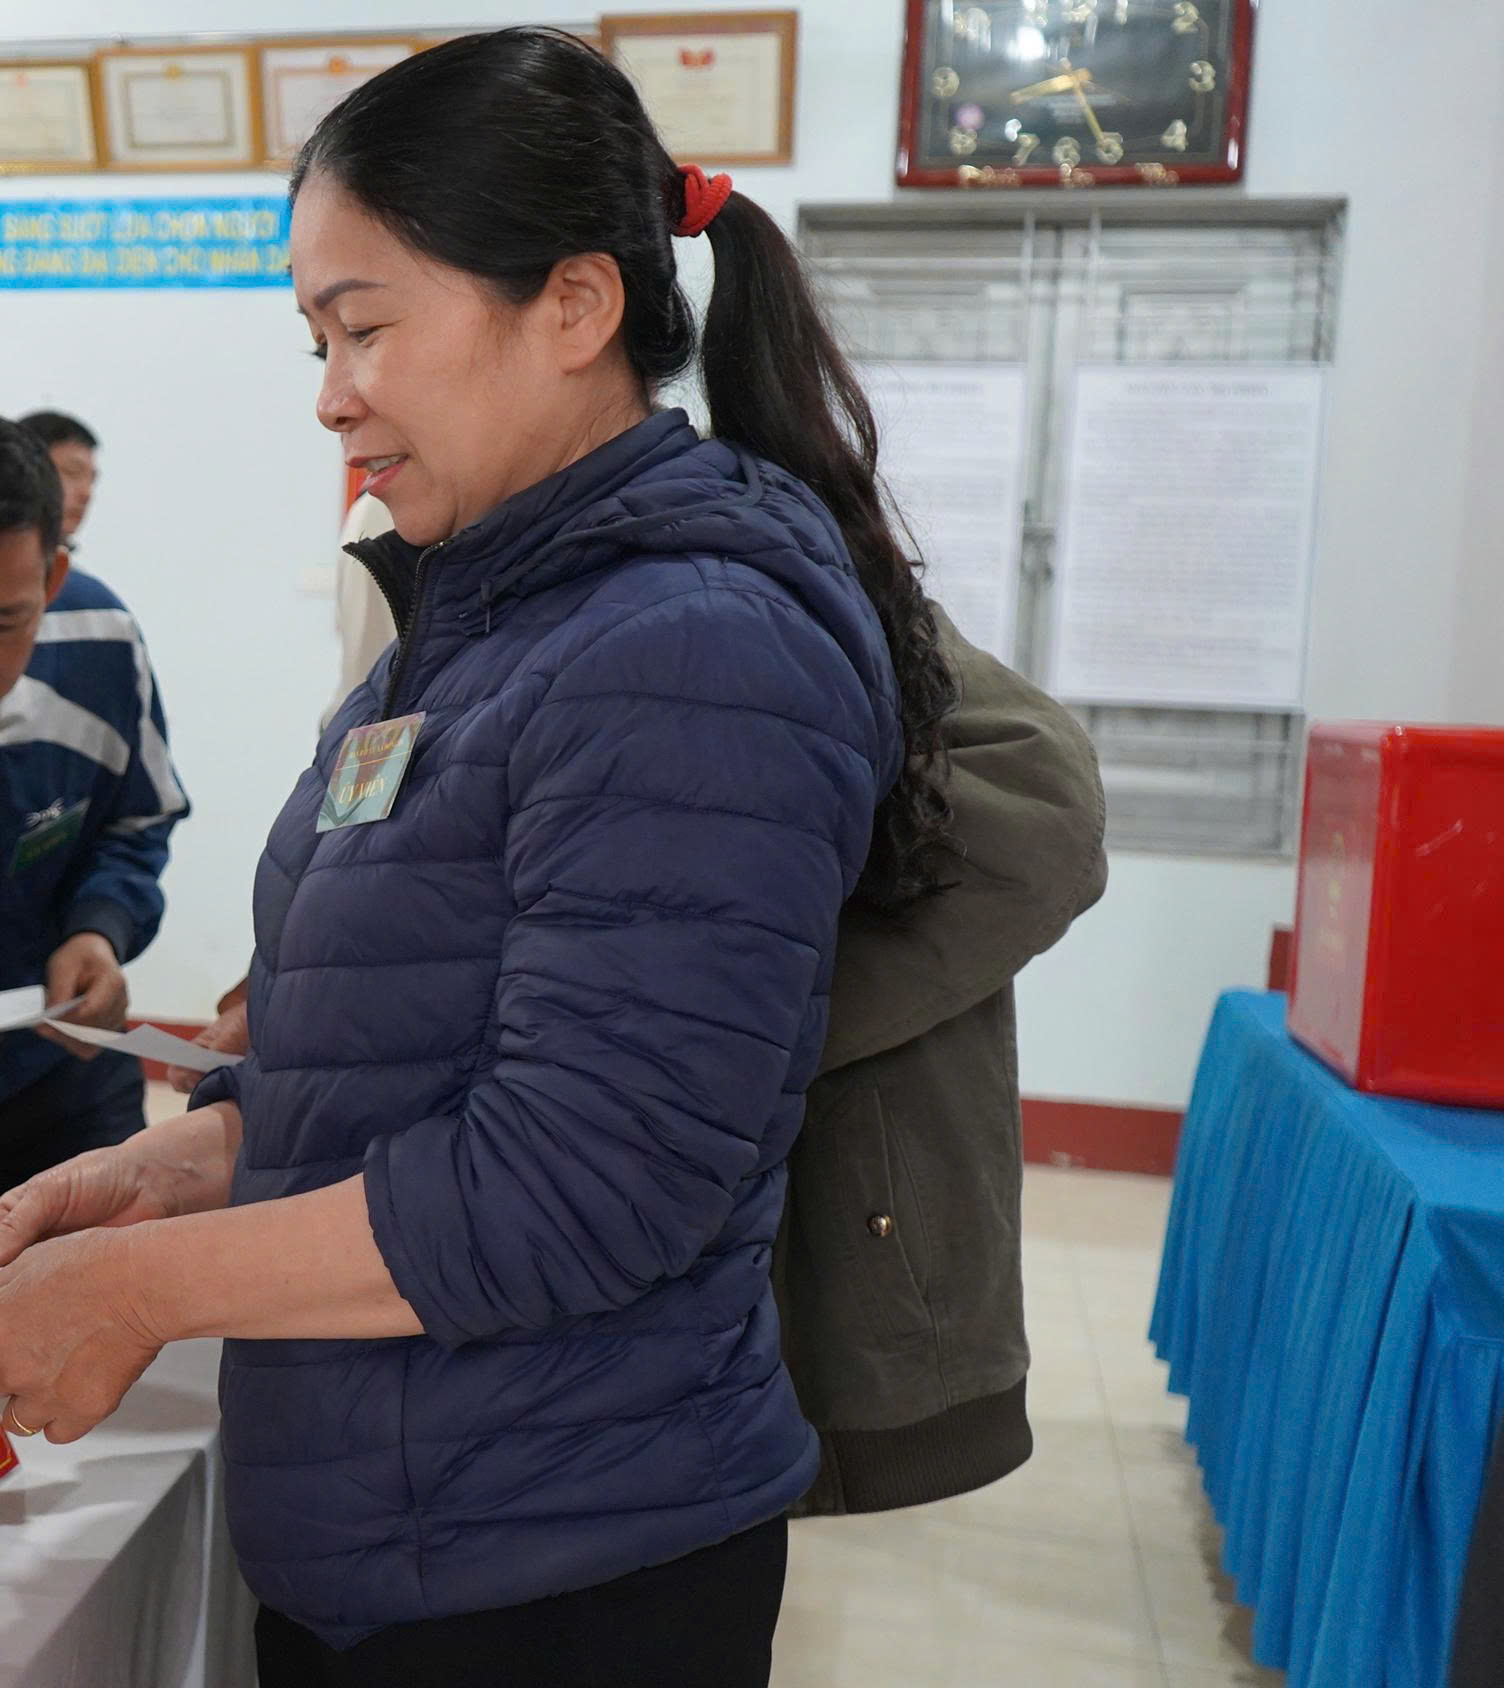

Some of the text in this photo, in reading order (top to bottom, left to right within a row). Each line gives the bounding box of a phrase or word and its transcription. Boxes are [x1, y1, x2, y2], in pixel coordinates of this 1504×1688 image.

[932, 67, 959, 97] 9
[1189, 60, 1216, 92] 3
[1012, 133, 1040, 166] 7
[1160, 119, 1188, 151] 4
